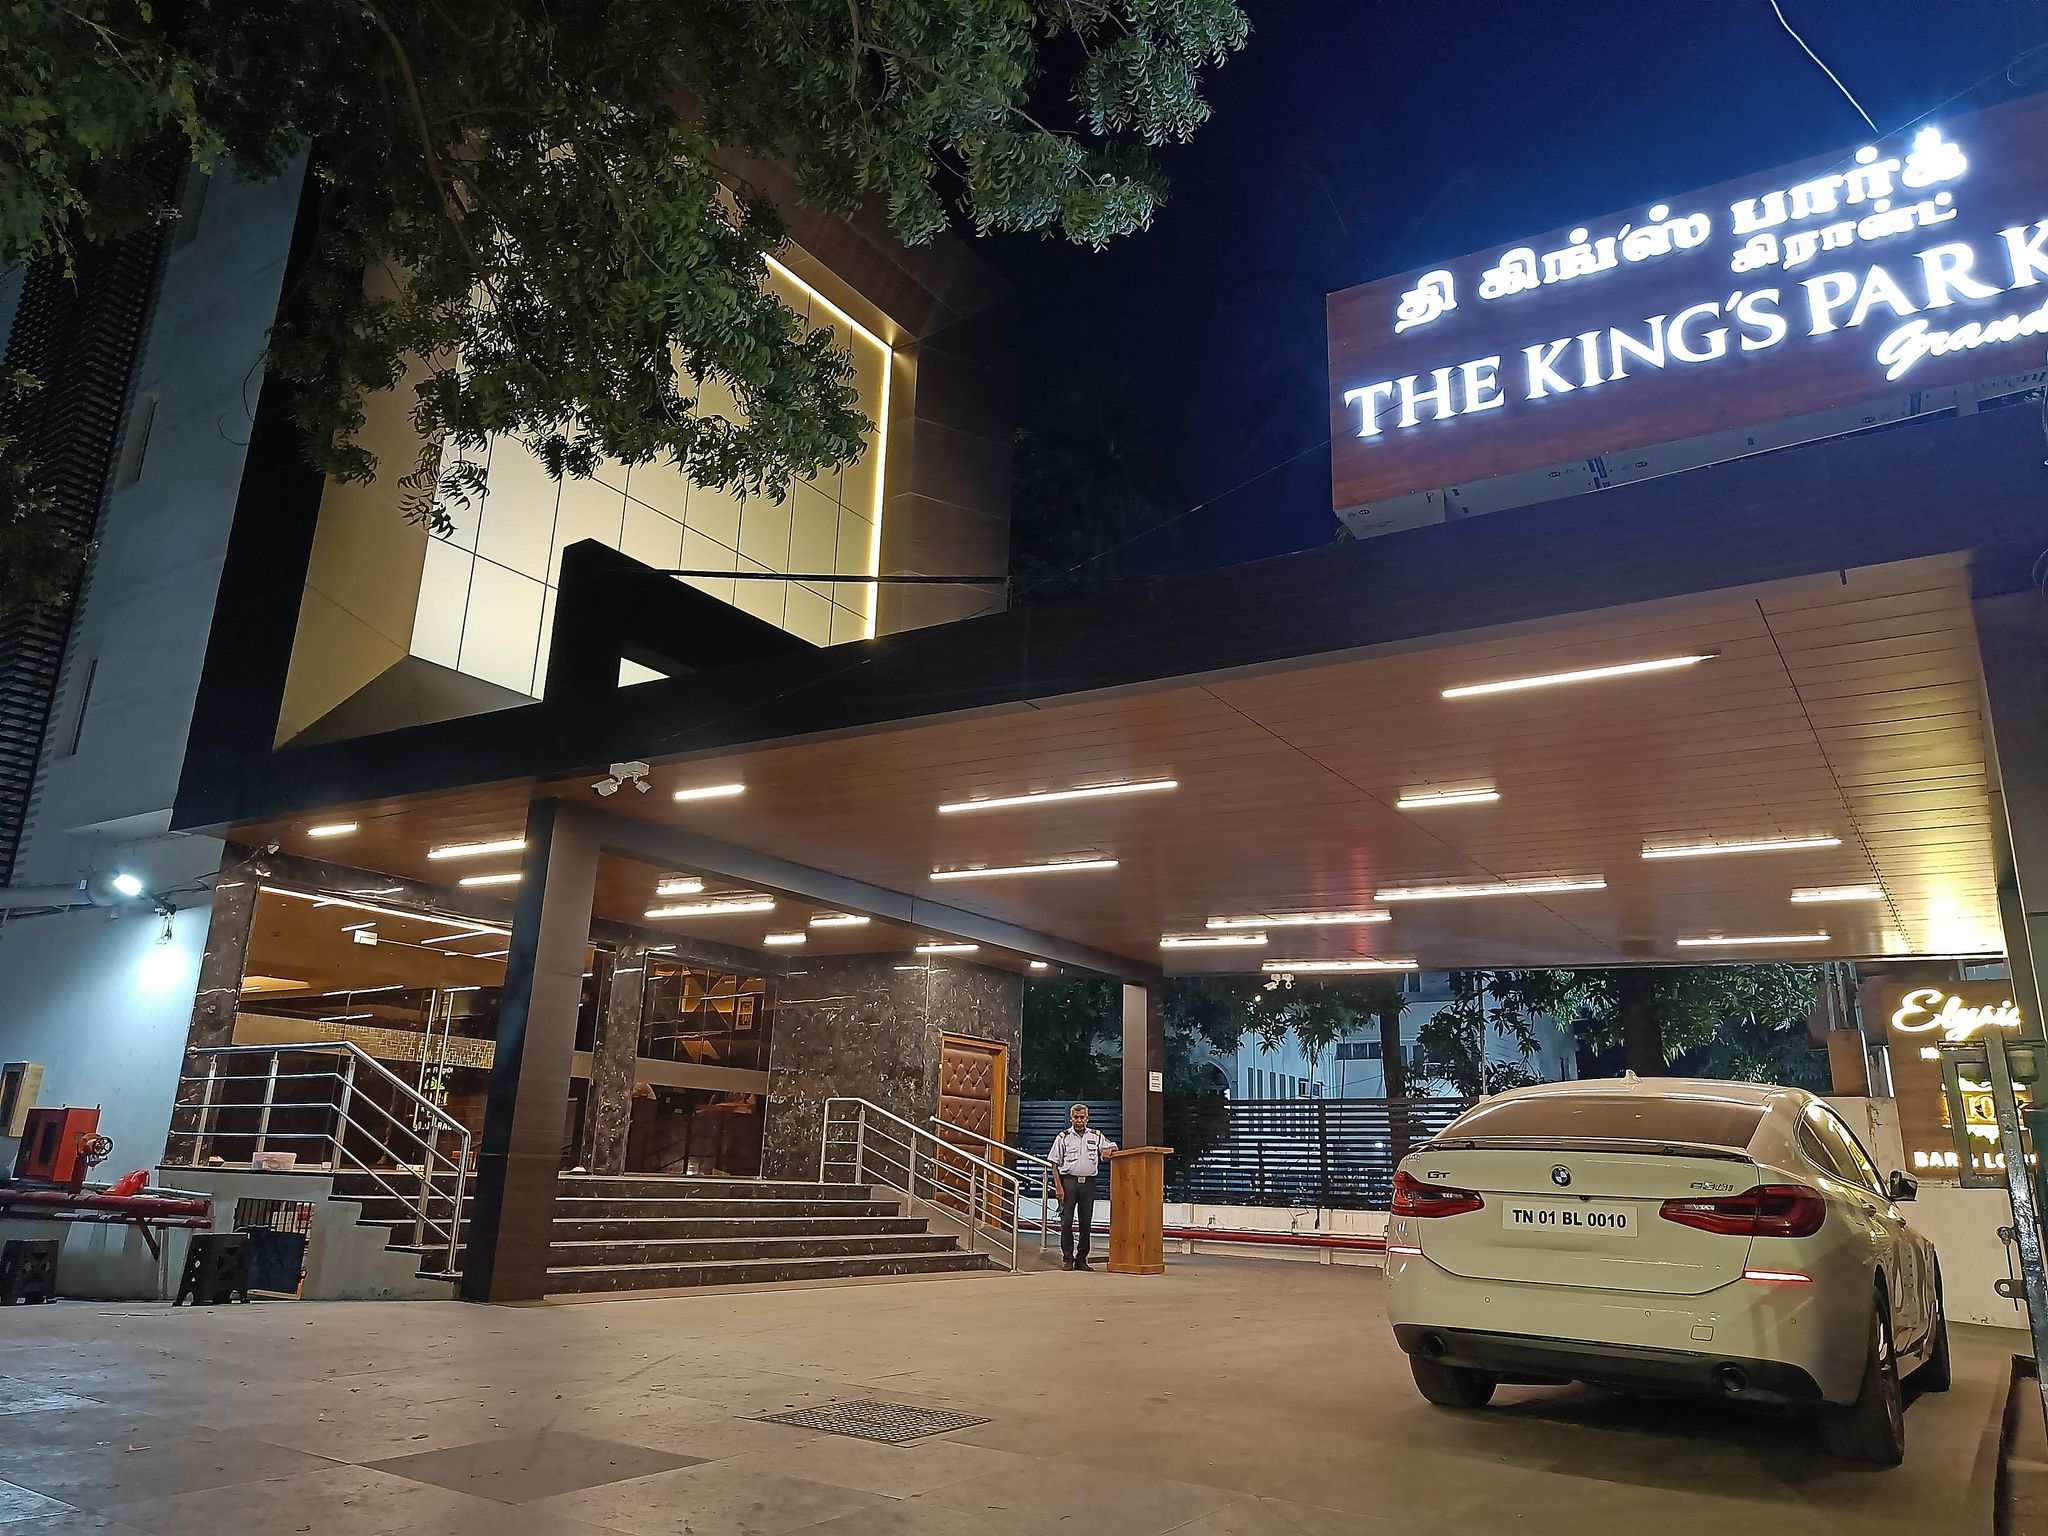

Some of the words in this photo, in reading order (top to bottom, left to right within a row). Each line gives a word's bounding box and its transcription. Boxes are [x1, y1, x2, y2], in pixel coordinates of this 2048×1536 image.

[1394, 269, 1458, 334] தி
[1730, 124, 1968, 235] பார்க்
[1730, 191, 1957, 273] கிராண்ட்
[1344, 355, 1505, 437] THE
[1521, 288, 1787, 400] KING'S
[1798, 219, 2048, 336] PARK
[1427, 1170, 1451, 1179] GT
[1913, 1151, 1959, 1168] BAR
[1512, 1209, 1534, 1224] TN
[1538, 1210, 1555, 1225] 01
[1562, 1211, 1583, 1226] BL
[1587, 1212, 1627, 1229] 0010
